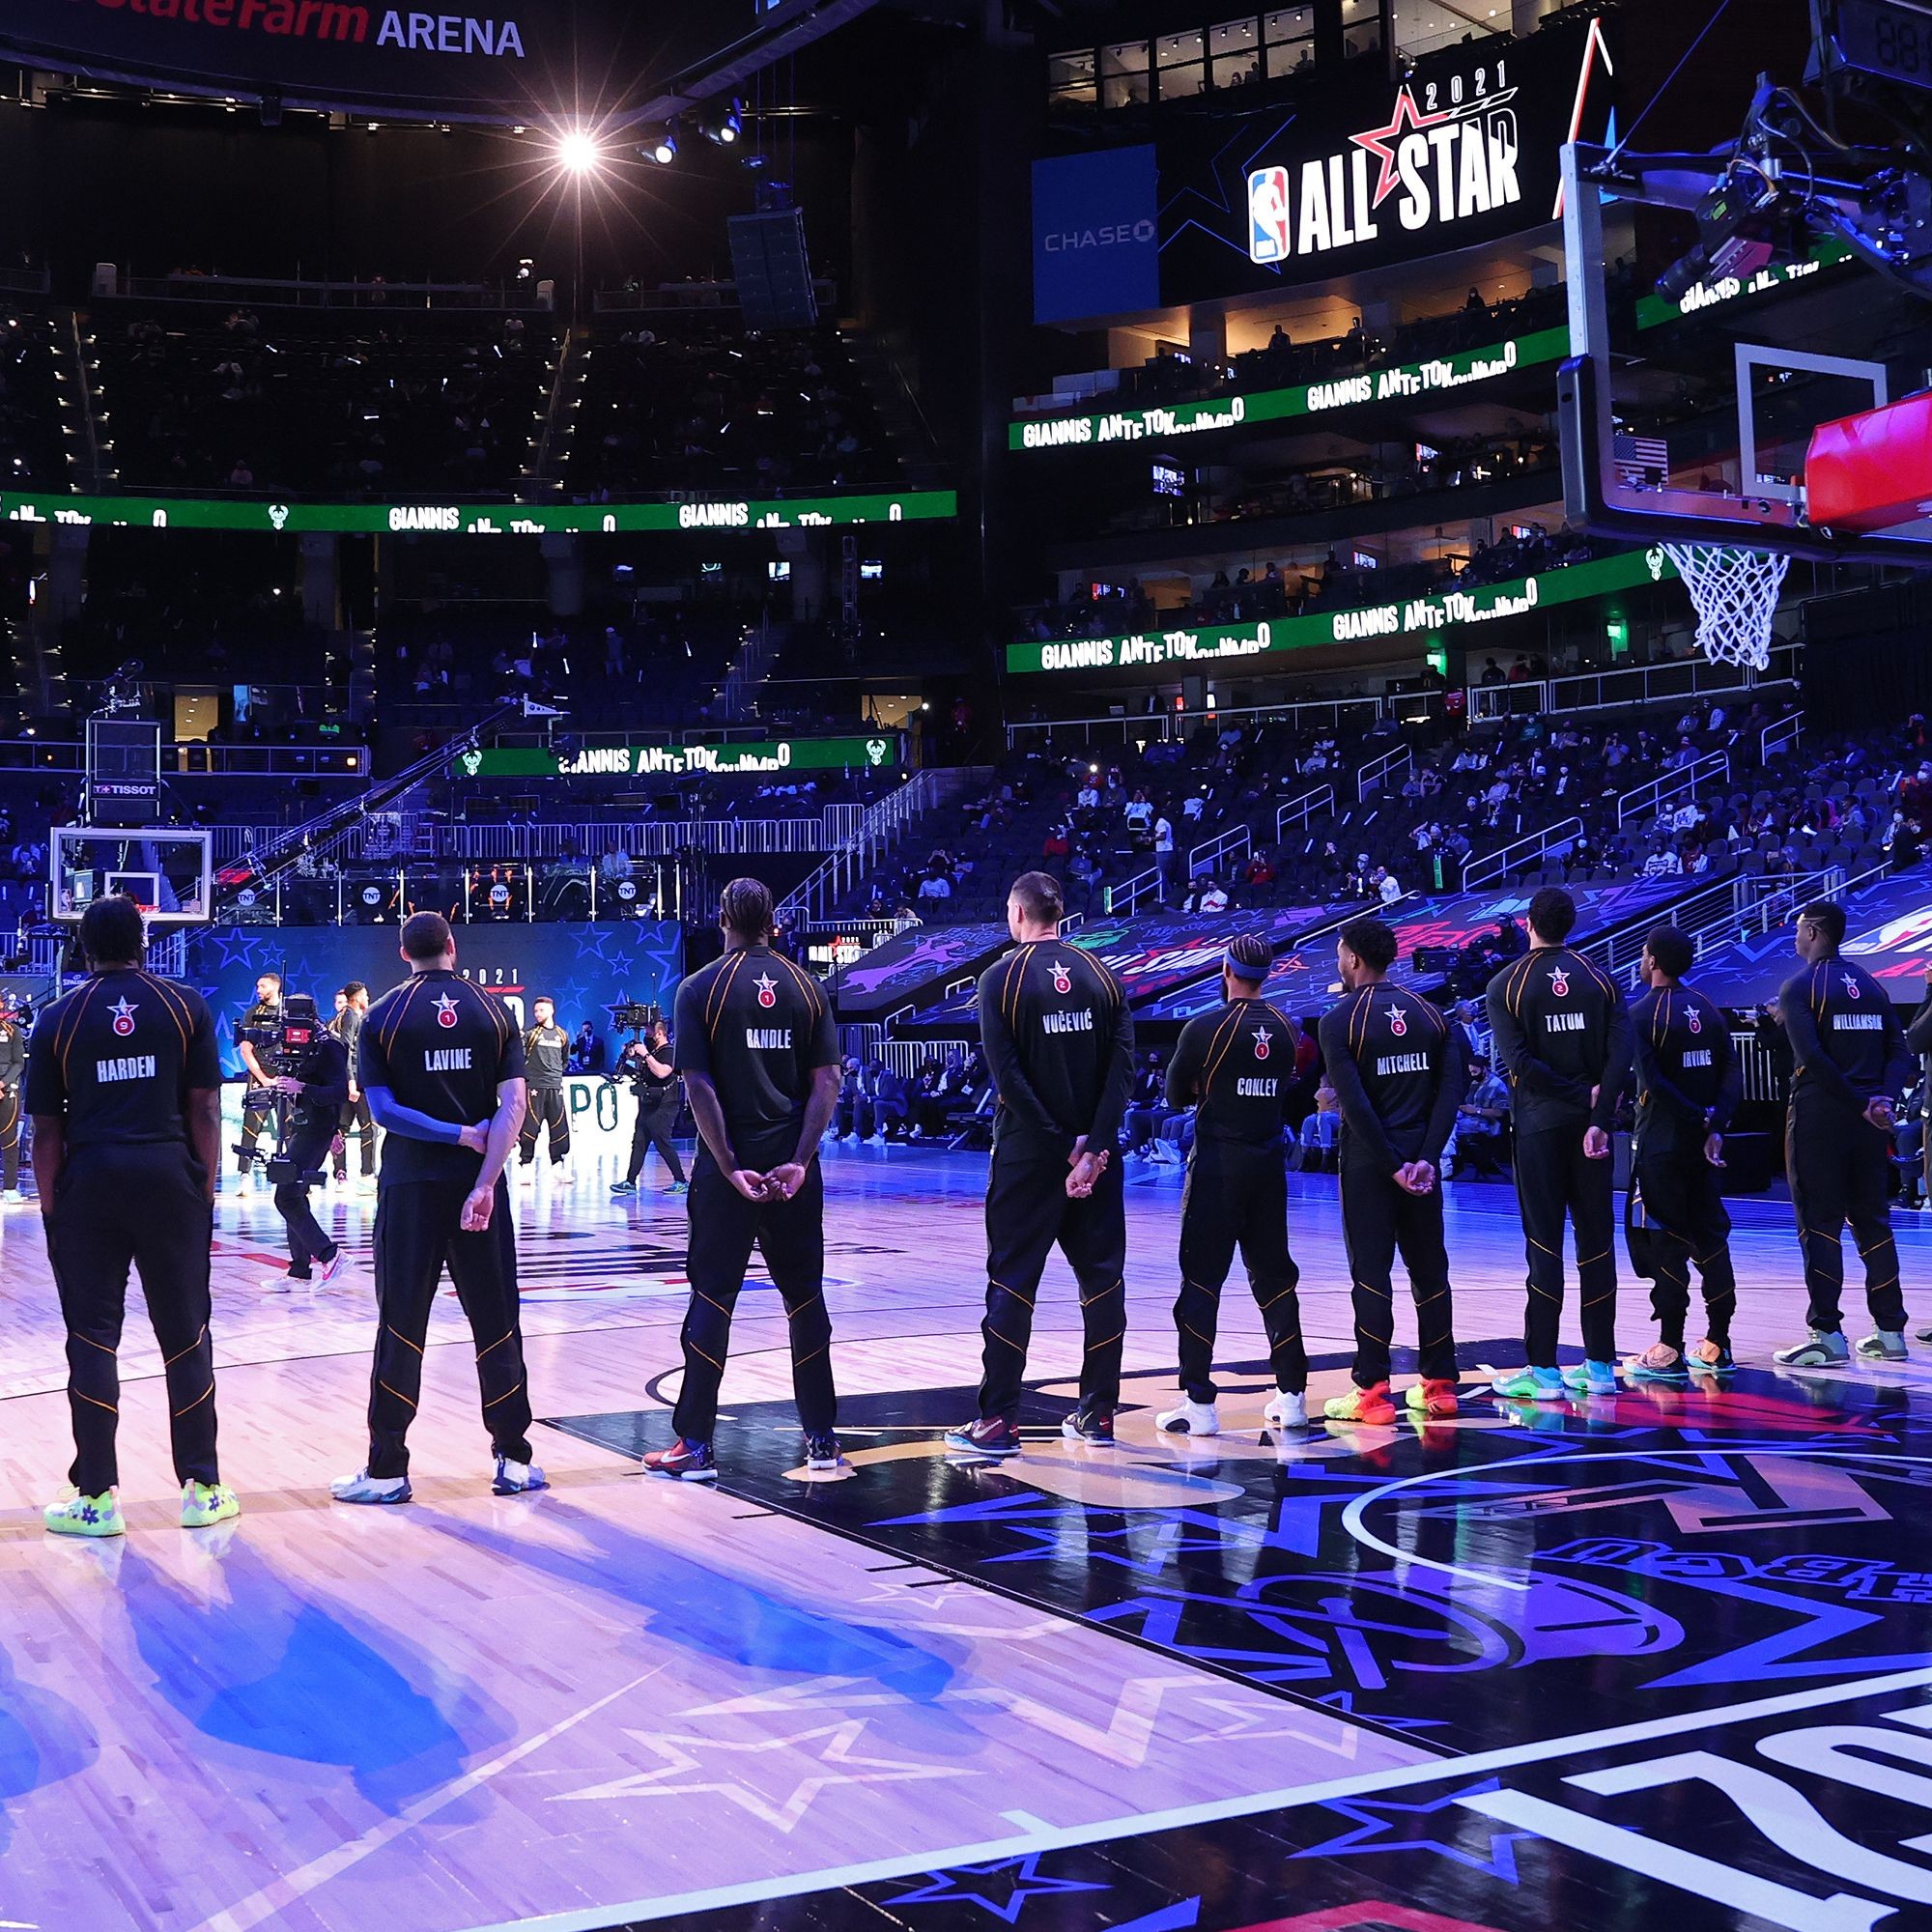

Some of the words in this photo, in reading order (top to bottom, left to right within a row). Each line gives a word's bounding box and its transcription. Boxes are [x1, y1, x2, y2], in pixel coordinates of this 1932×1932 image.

[97, 0, 370, 43] ateFarm
[376, 10, 525, 57] ARENA
[1426, 60, 1506, 111] 2021
[1297, 148, 1378, 255] ALL
[1397, 107, 1521, 231] STAR
[1045, 224, 1131, 252] CHASE
[1307, 375, 1373, 412] GIANNIS
[1023, 417, 1093, 447] GIANNIS
[388, 507, 460, 531] GIANNIS
[679, 502, 749, 528] GIANNIS
[1332, 605, 1399, 640] GIANNIS
[1041, 639, 1113, 669] GIANNIS
[110, 785, 156, 794] TISSOT
[463, 969, 518, 984] 2021
[120, 1021, 128, 1030] 9
[444, 1014, 451, 1023] 1
[1043, 1008, 1093, 1035] VUČEVIĆ
[1545, 1012, 1585, 1033] TATUM
[1833, 1013, 1884, 1031] WILLIAMSON
[746, 1028, 792, 1049] RANDLE
[97, 1055, 156, 1083] HARDEN
[425, 1048, 472, 1071] LAVINE
[1377, 1051, 1430, 1076] MITCHELL
[1683, 1049, 1712, 1067] IRVING
[1236, 1077, 1278, 1097] CONLEY
